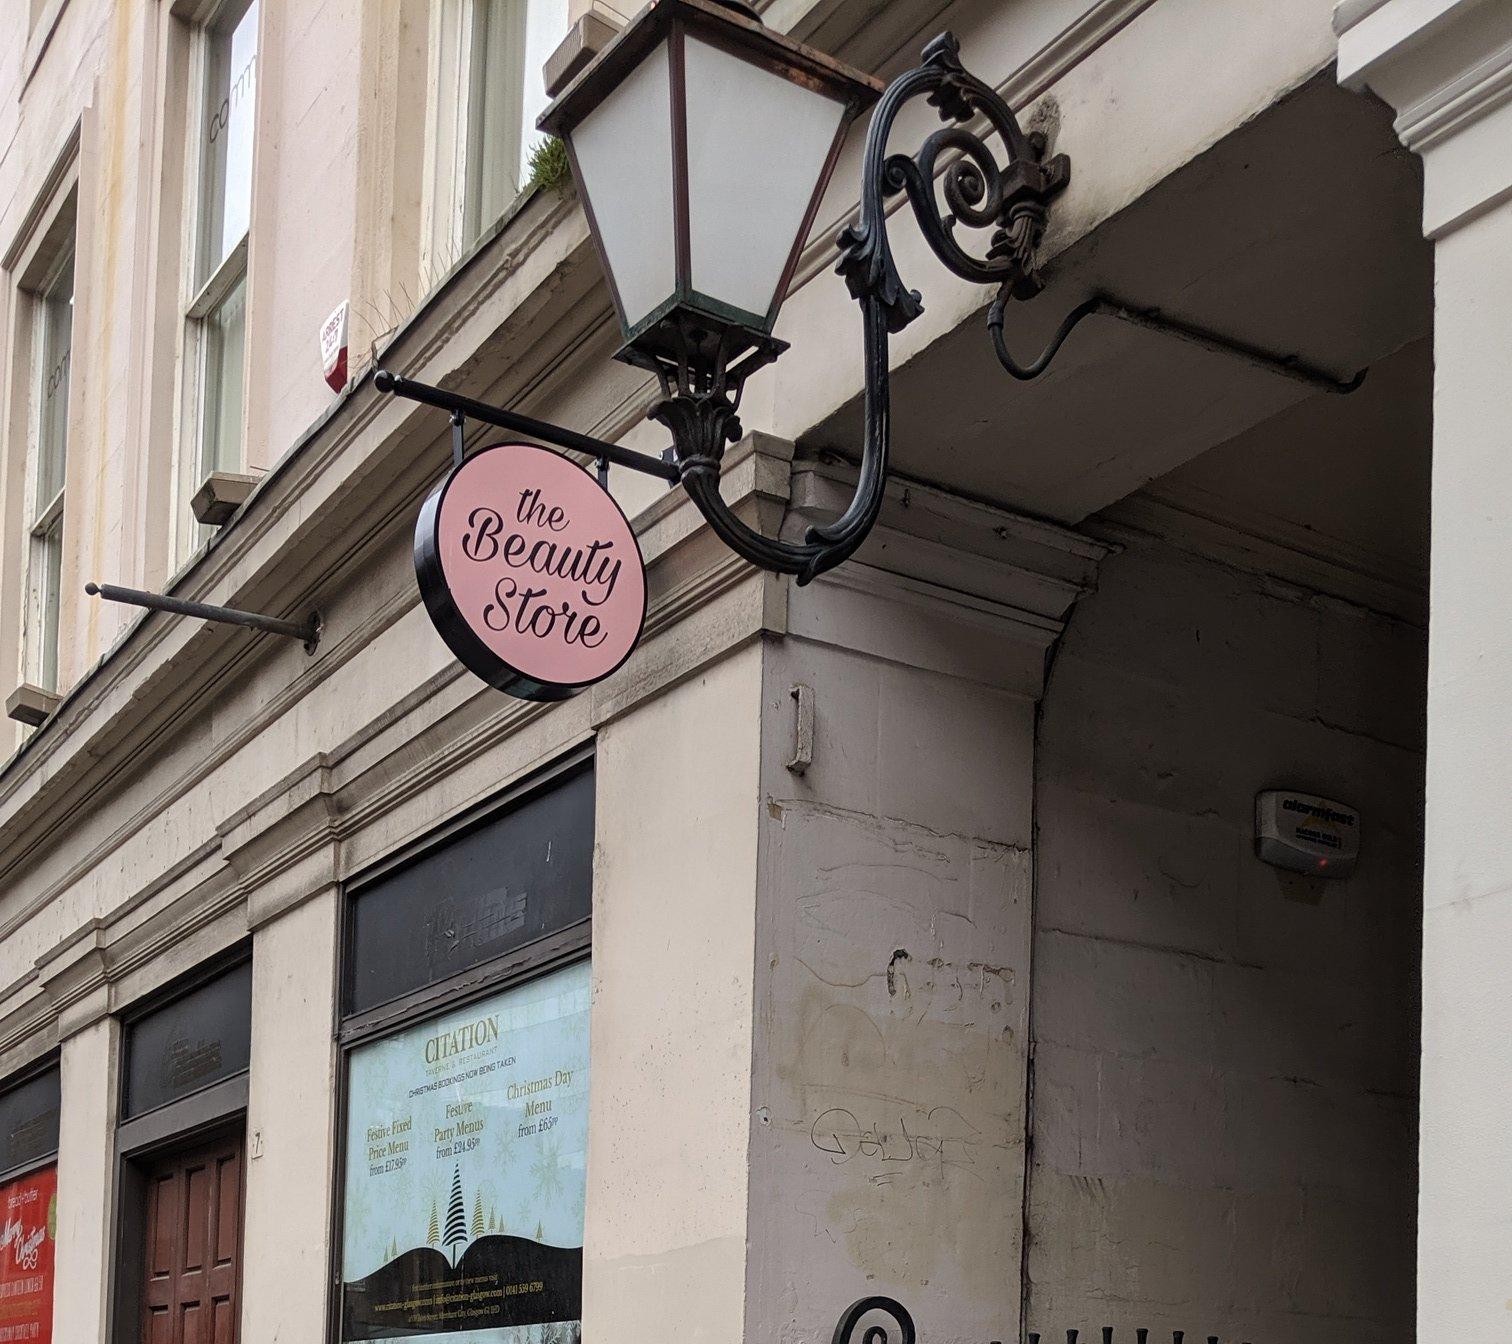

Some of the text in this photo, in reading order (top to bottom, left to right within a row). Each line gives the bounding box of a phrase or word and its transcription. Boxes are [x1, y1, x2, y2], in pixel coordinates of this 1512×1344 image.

[516, 489, 570, 532] the
[462, 507, 622, 607] Beauty
[483, 577, 609, 649] Store
[425, 1014, 500, 1064] CITATION
[409, 1056, 517, 1098] CHRISTMAS BOOKINGS NOW BEING TAKEN
[507, 1070, 574, 1101] Christmas Day
[446, 1102, 473, 1119] Festive
[525, 1100, 552, 1118] Menu
[367, 1115, 412, 1142] Festive Fixed
[434, 1119, 484, 1144] Party Menus
[518, 1122, 537, 1140] from
[368, 1140, 409, 1161] Price Menu
[436, 1145, 452, 1159] from
[370, 1164, 384, 1177] from
